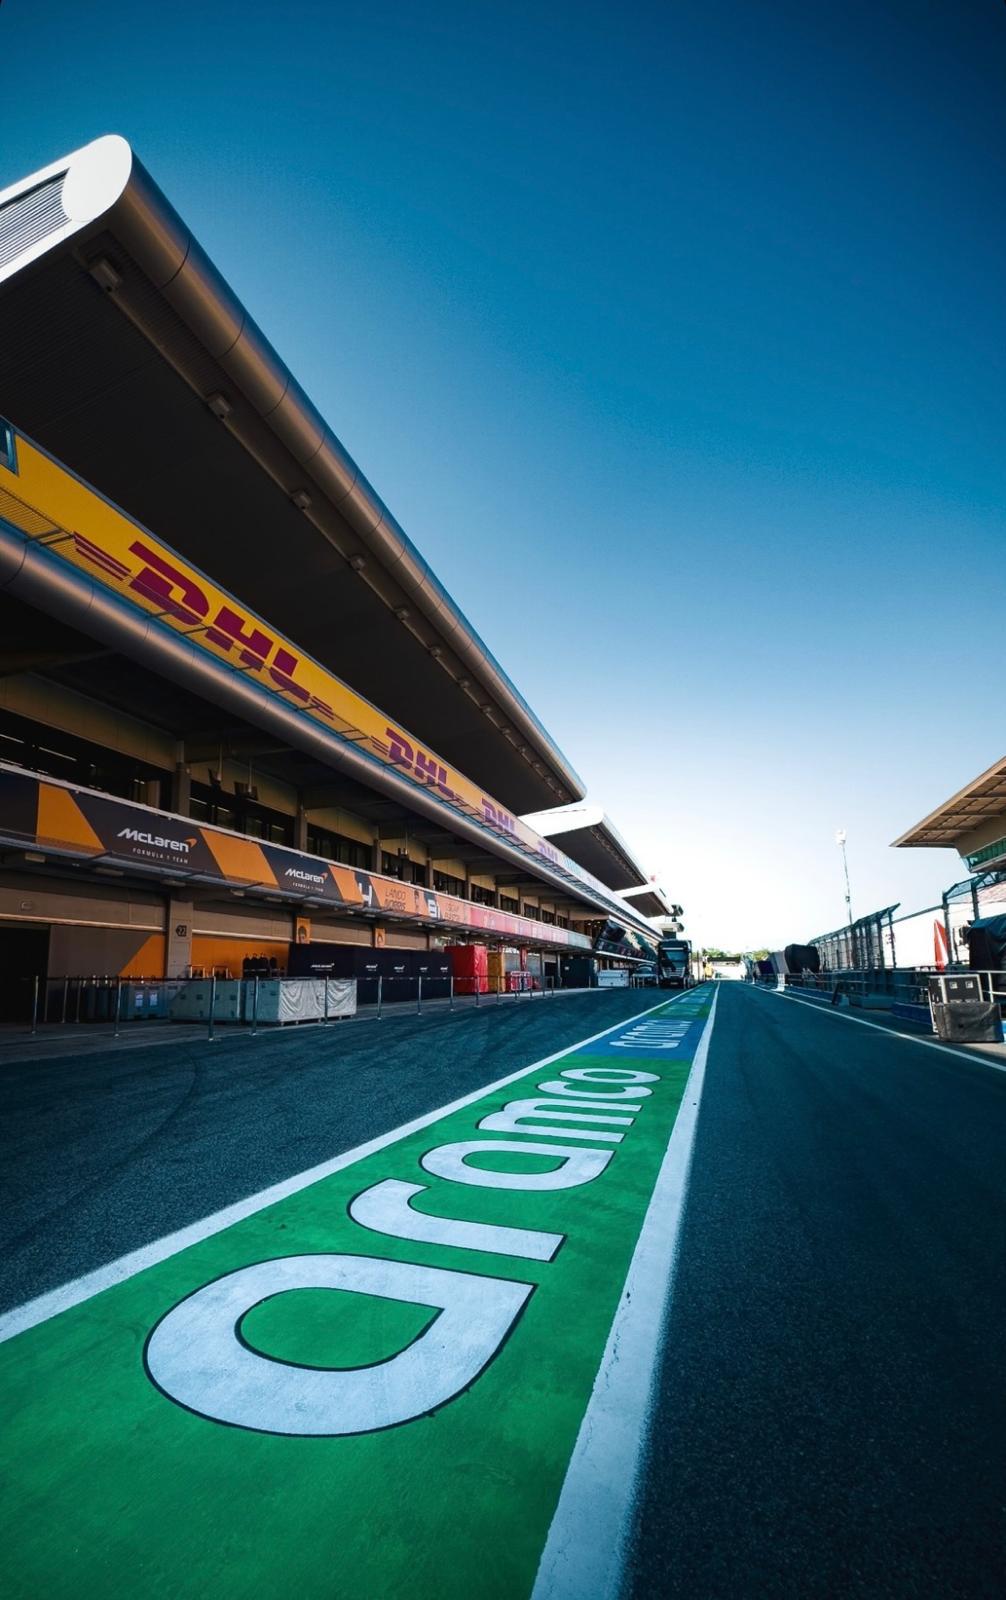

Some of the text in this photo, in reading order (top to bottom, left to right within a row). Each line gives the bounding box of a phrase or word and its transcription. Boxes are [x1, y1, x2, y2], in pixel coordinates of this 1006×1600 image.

[128, 541, 310, 703] DHL
[385, 727, 455, 800] DHL
[117, 828, 189, 853] McLaren
[481, 798, 520, 842] DHL
[132, 848, 163, 859] FORMULA
[173, 856, 188, 864] TEAM
[285, 868, 324, 884] McLaren
[144, 1067, 661, 1437] aramco
